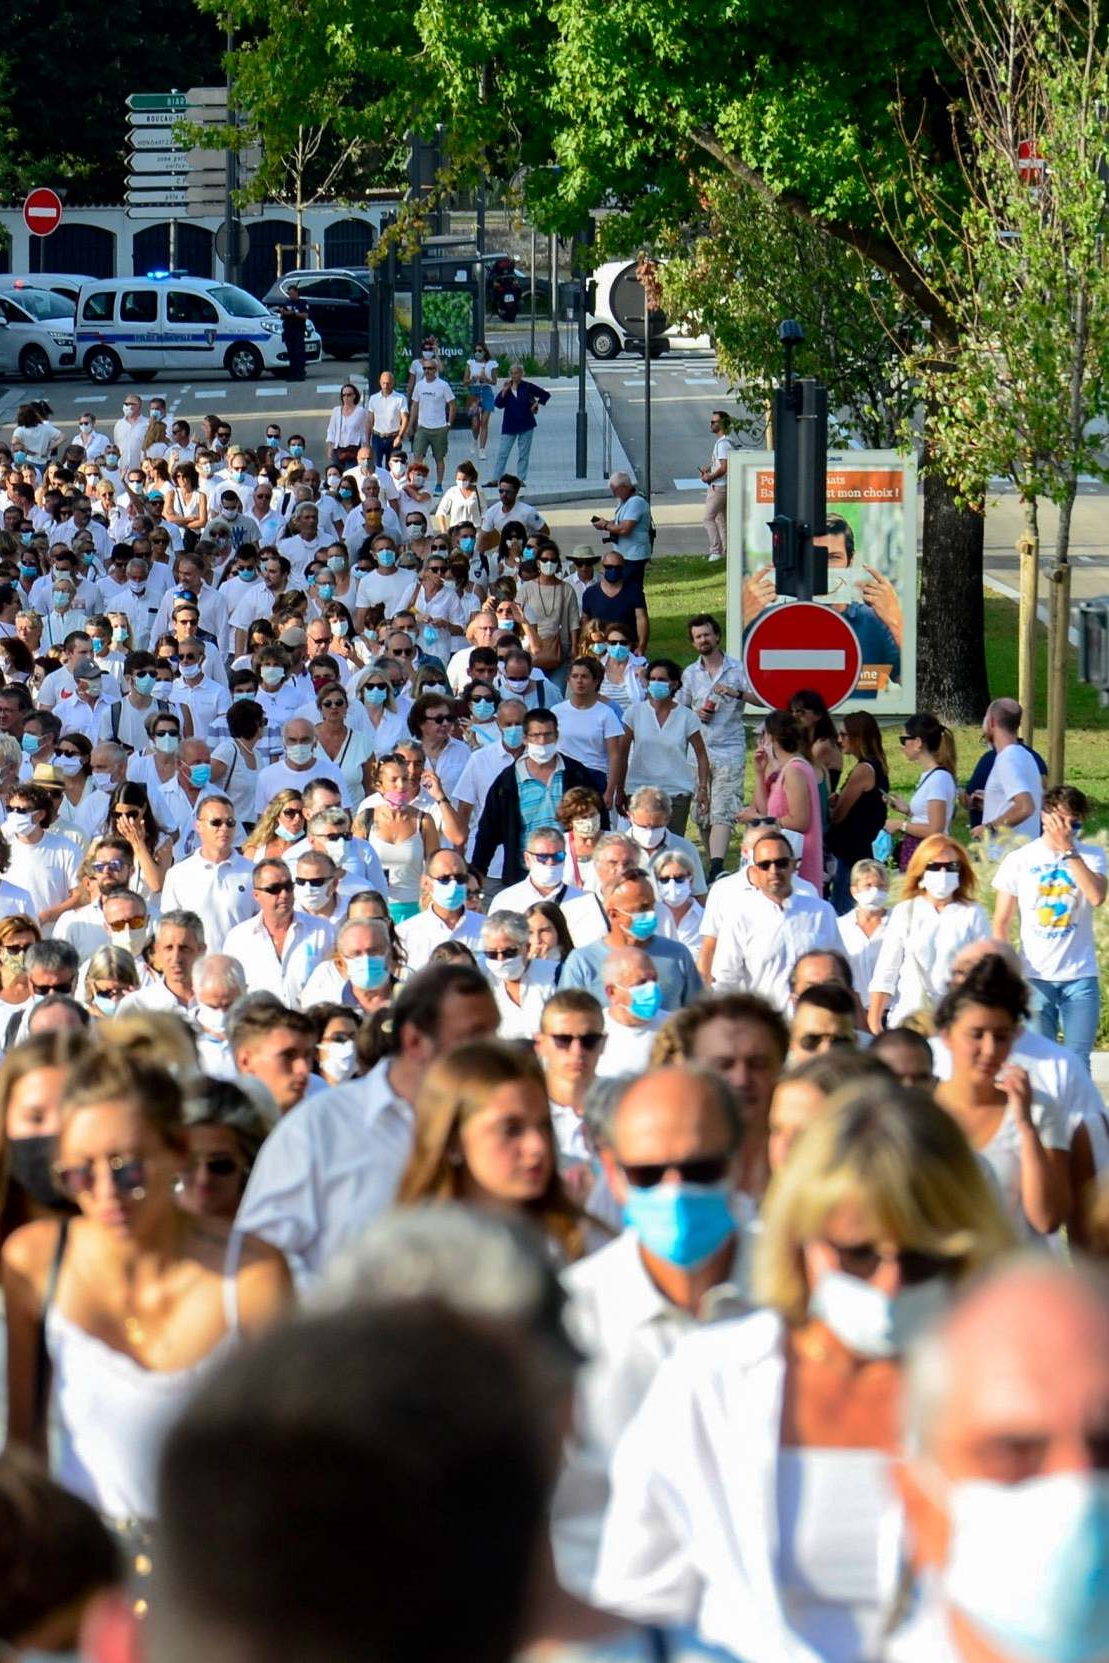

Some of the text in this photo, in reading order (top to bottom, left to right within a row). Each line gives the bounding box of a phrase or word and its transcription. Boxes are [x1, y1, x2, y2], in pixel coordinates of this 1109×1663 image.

[760, 475, 846, 486] Po ats
[760, 488, 775, 498] Ba
[837, 489, 861, 498] mon
[863, 487, 893, 498] choix
